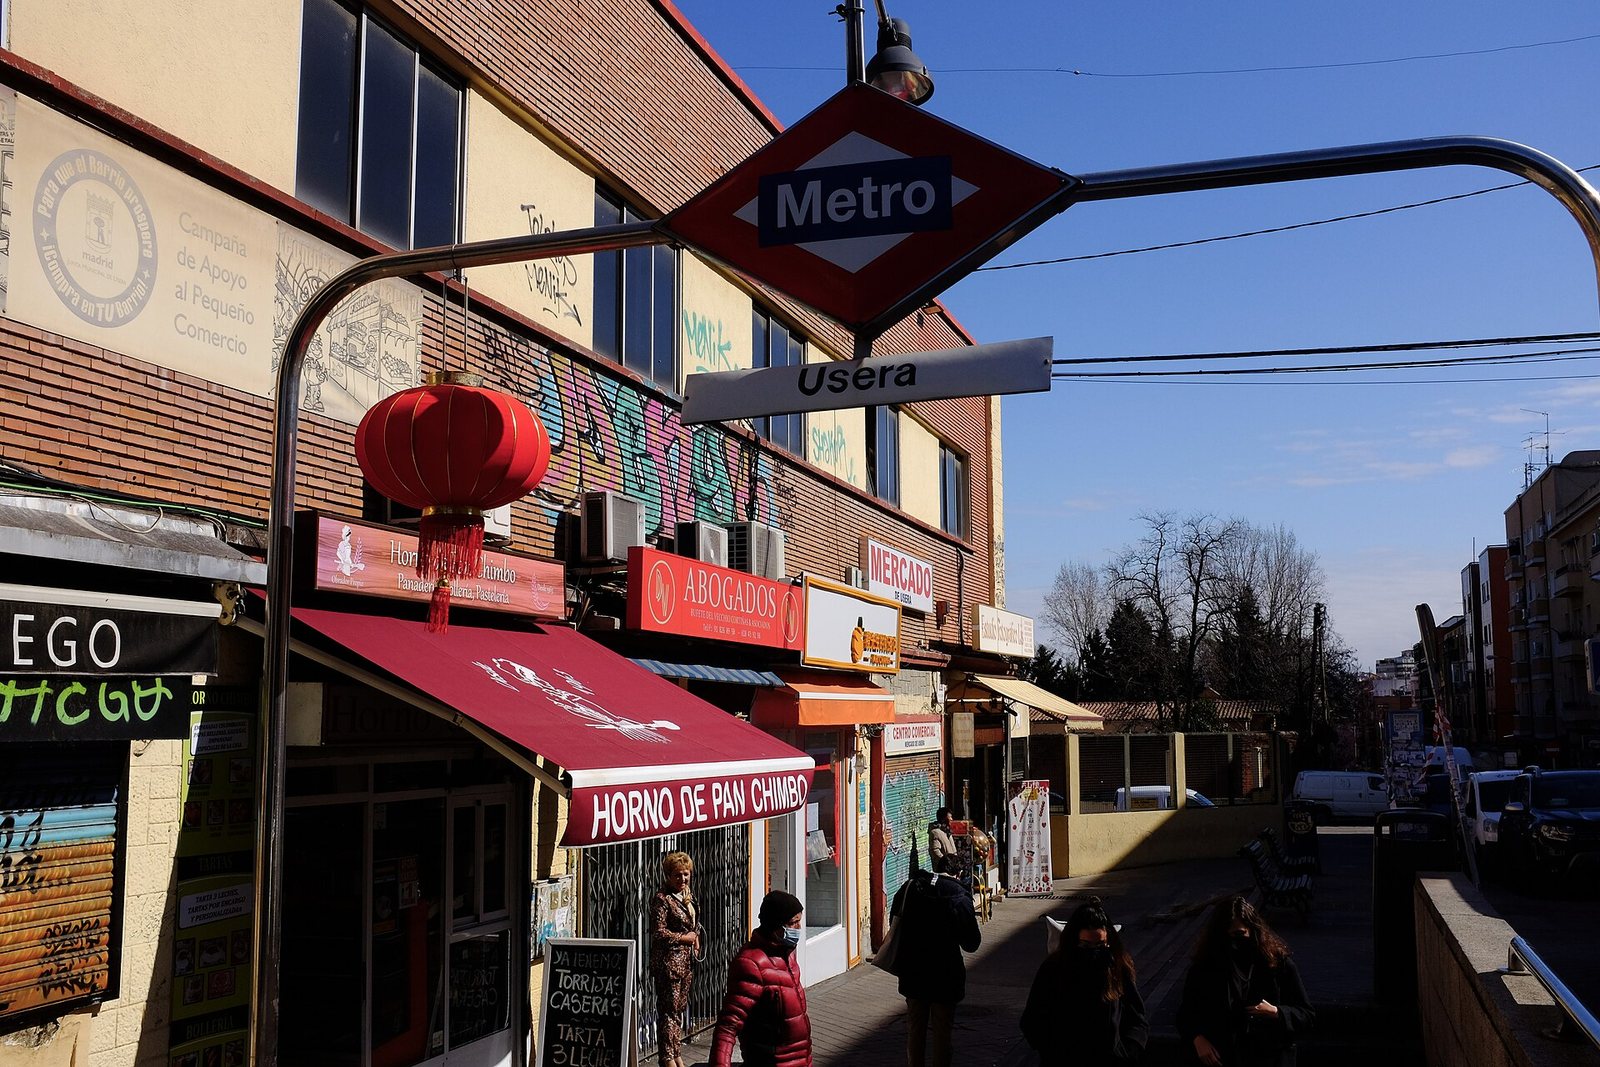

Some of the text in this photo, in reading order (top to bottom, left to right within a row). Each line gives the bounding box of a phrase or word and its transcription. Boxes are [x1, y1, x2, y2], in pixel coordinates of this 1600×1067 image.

[37, 154, 153, 259] Para que el Barrio prospere
[776, 176, 935, 229] Metro
[178, 211, 248, 258] Campaña
[82, 252, 114, 270] madrid
[177, 246, 248, 291] de Apoyo
[80, 300, 96, 318] en
[97, 303, 116, 323] TU
[175, 281, 255, 325] al Pequeño
[174, 313, 248, 356] Comercio
[797, 362, 917, 397] Usera
[683, 567, 777, 619] ABOGADOS
[870, 544, 931, 599] MERCADO
[13, 613, 121, 668] EGO
[893, 725, 936, 740] CENTRO COMERCIAL
[591, 774, 808, 839] HORNO DE PAN CHIMBO
[550, 991, 623, 1017] CASERAS
[556, 969, 623, 997] TORRIJAS
[552, 1043, 568, 1065] 3
[557, 1023, 606, 1048] TARTA
